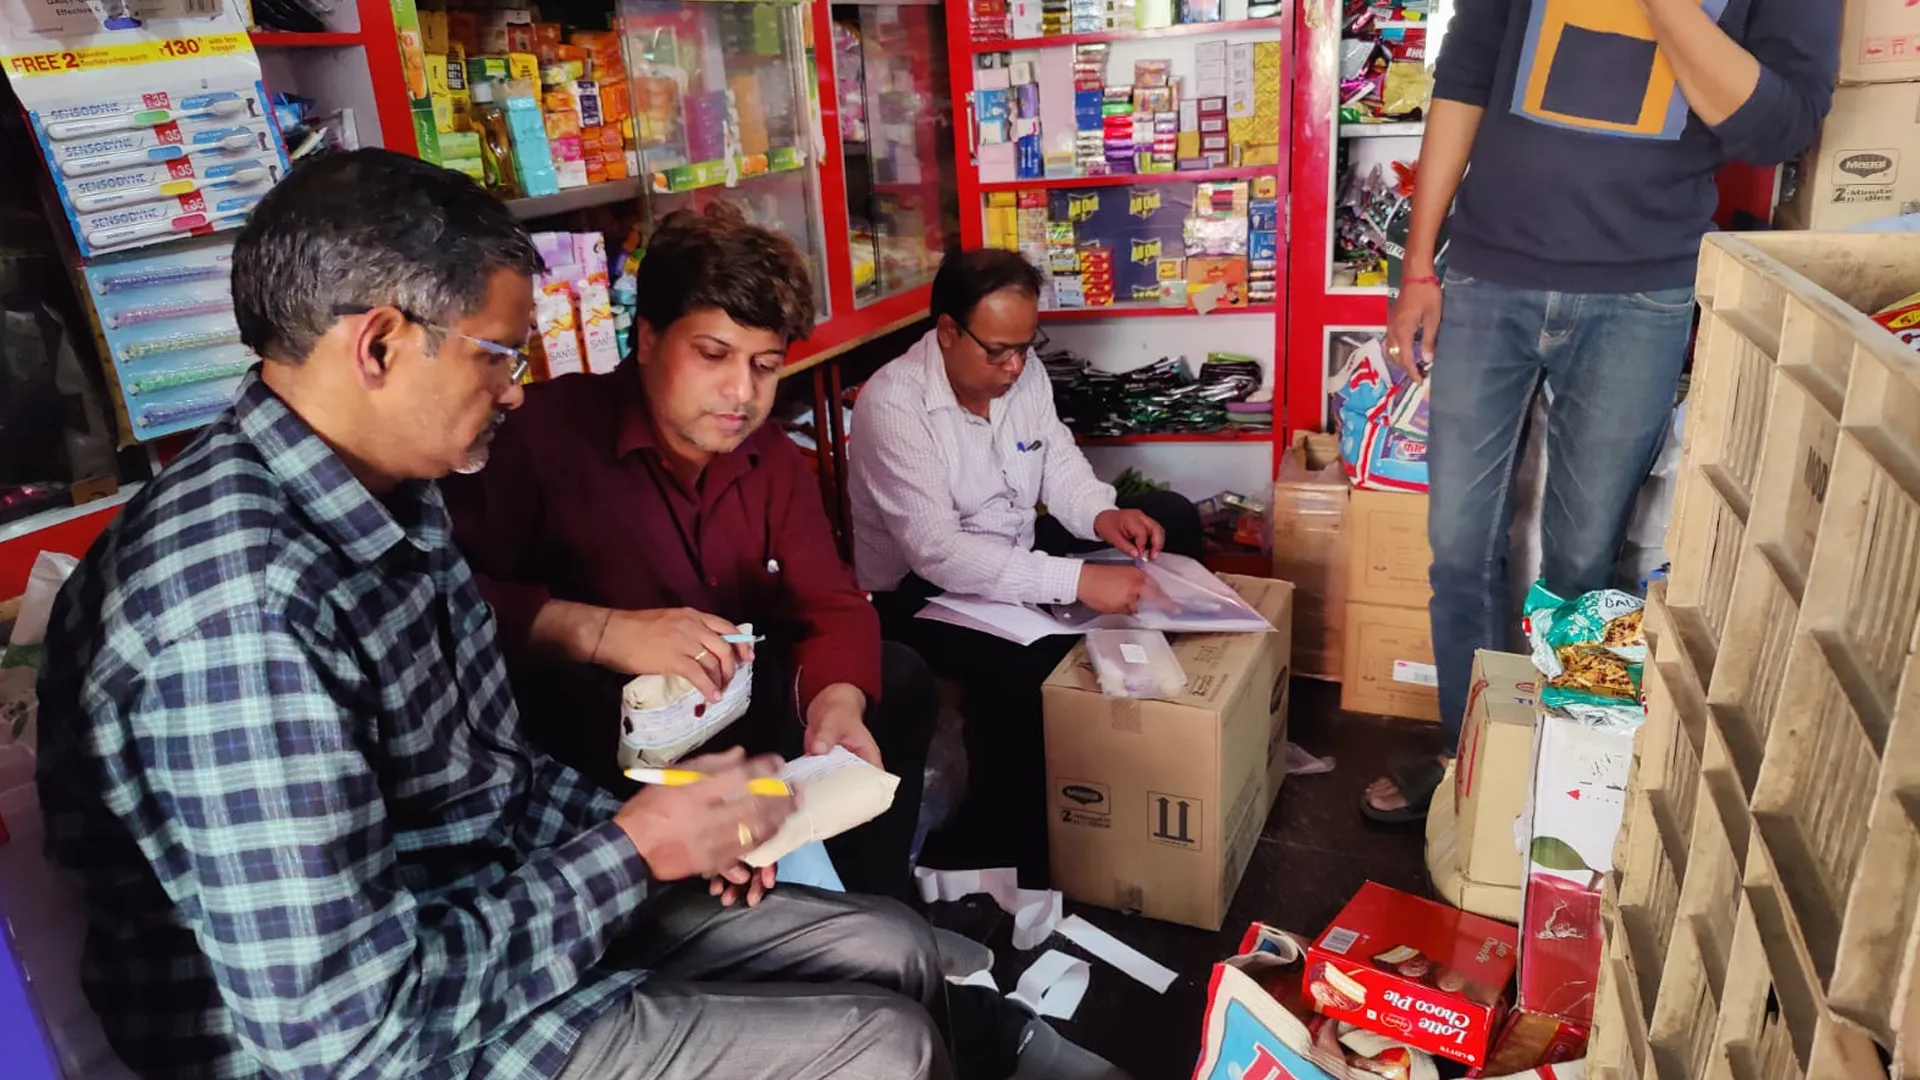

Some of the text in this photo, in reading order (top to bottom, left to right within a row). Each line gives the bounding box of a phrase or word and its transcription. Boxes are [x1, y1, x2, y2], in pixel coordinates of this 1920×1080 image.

[11, 52, 82, 73] FREE 2
[64, 138, 134, 157] SENSODYNE
[78, 173, 146, 193] SENSODYNE
[91, 207, 157, 228] SENSODYNE
[1383, 989, 1414, 1011] Pie
[1415, 1000, 1470, 1029] Choco
[1418, 1017, 1467, 1044] Lotte
